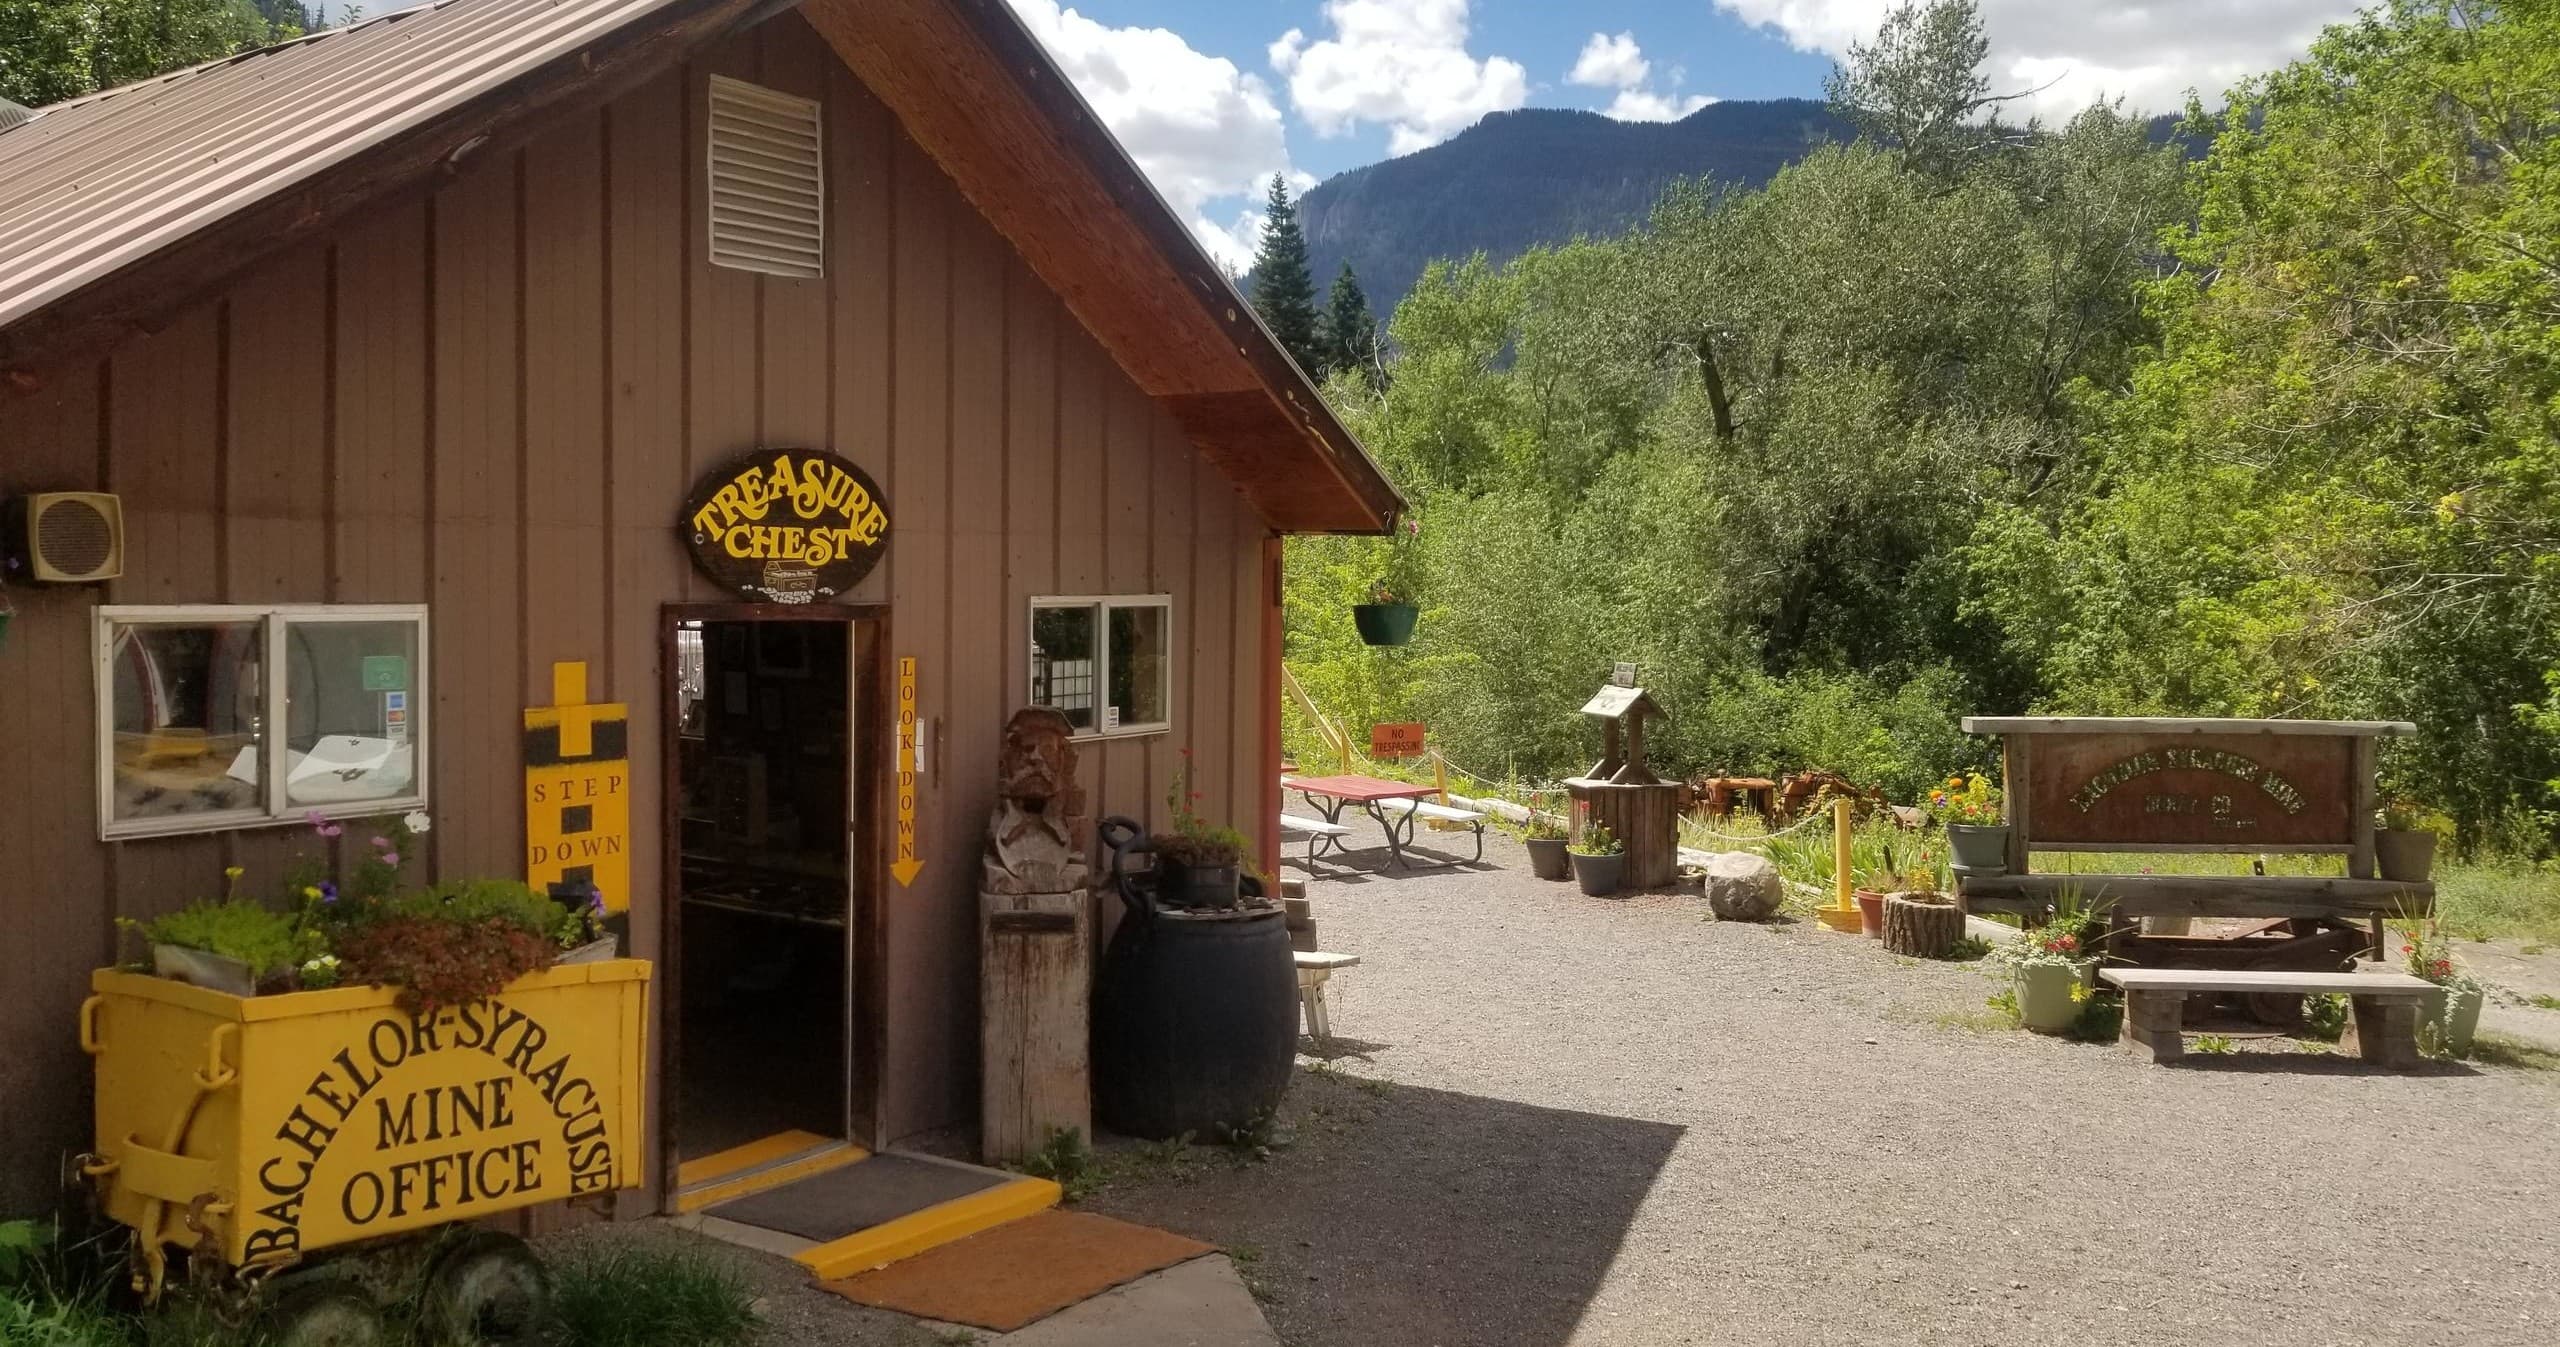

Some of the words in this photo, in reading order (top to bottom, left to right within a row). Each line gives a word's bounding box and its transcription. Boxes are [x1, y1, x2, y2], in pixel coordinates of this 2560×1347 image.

[693, 454, 888, 546] TREASURE
[724, 523, 849, 567] CHEST
[902, 660, 913, 750] LOOK
[1391, 728, 1405, 739] NO
[533, 775, 622, 803] STEP
[898, 771, 915, 859] DOWN
[532, 835, 622, 865] DOWN
[245, 998, 613, 1263] BACHELOR-SYRACUSE
[375, 1075, 514, 1151] MINE
[341, 1139, 542, 1226] OFFICE
